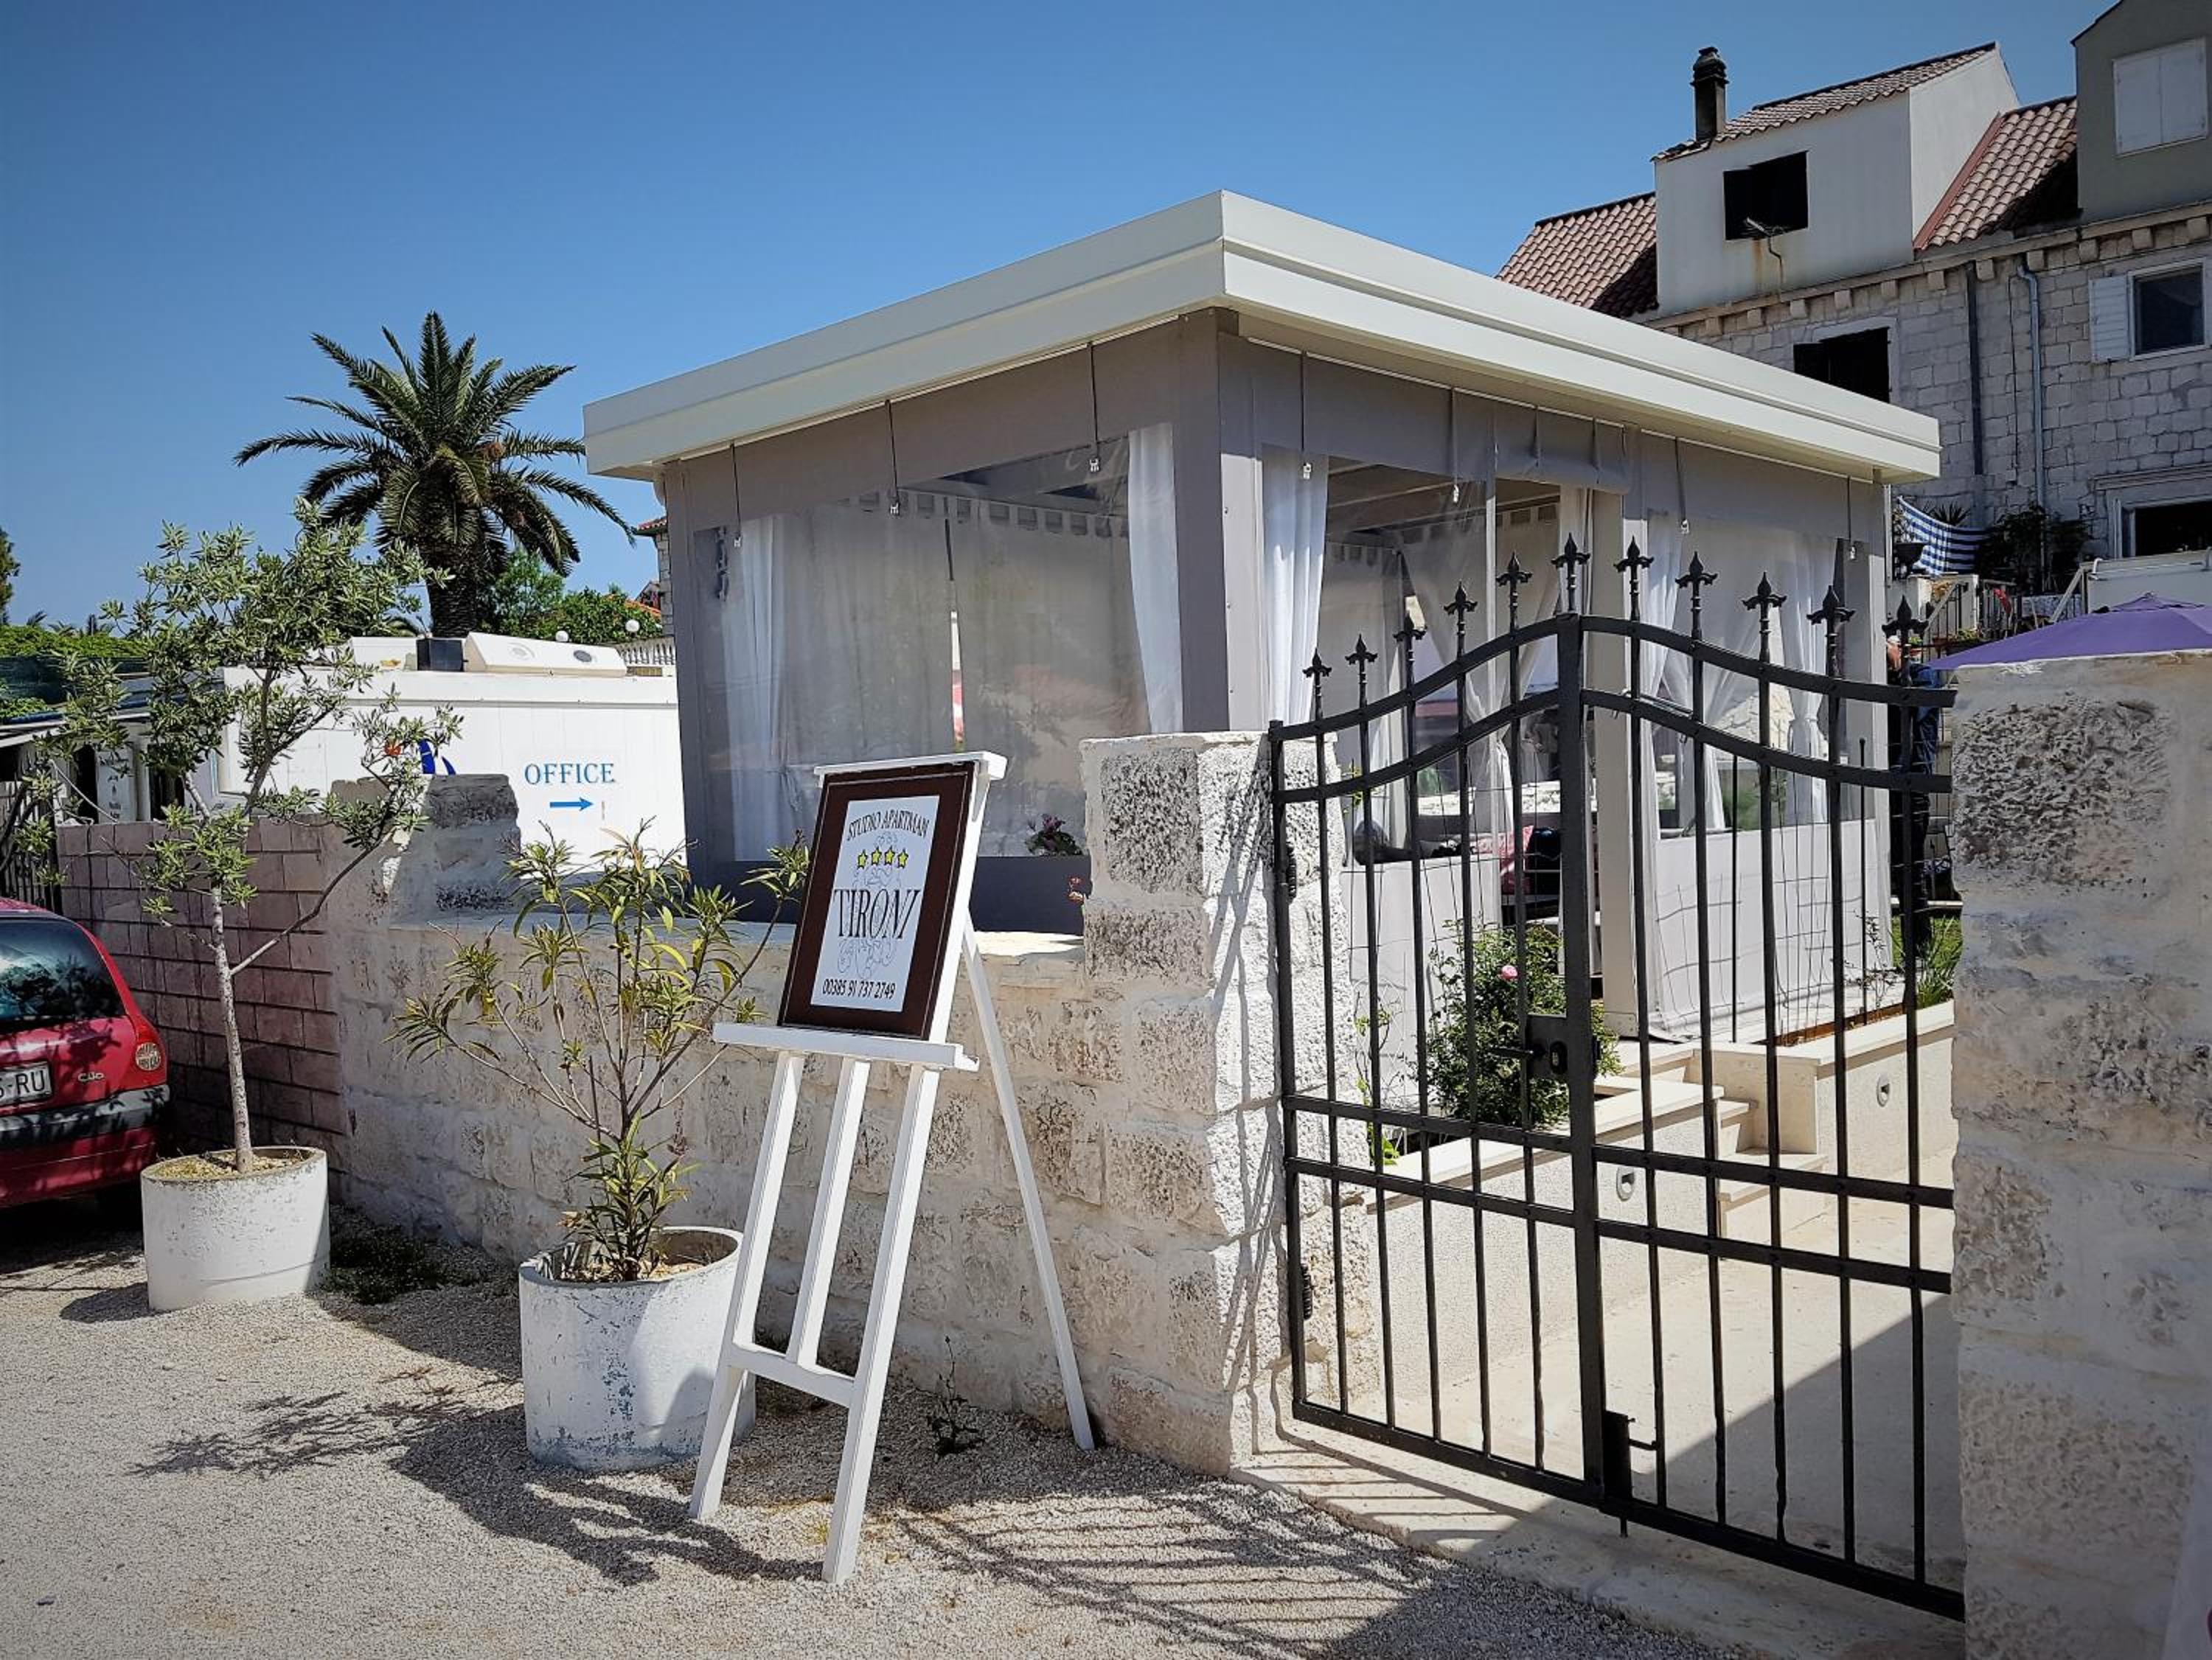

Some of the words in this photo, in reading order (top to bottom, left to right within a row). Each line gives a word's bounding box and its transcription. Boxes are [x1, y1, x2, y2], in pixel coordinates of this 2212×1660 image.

[524, 762, 615, 785] OFFICE
[846, 812, 882, 841] STUDIO
[881, 809, 930, 838] APARTMAN
[832, 888, 921, 939] TIRONI
[822, 978, 847, 996] 00385
[847, 980, 858, 997] 91
[858, 980, 874, 998] 737
[874, 981, 896, 1000] 2749
